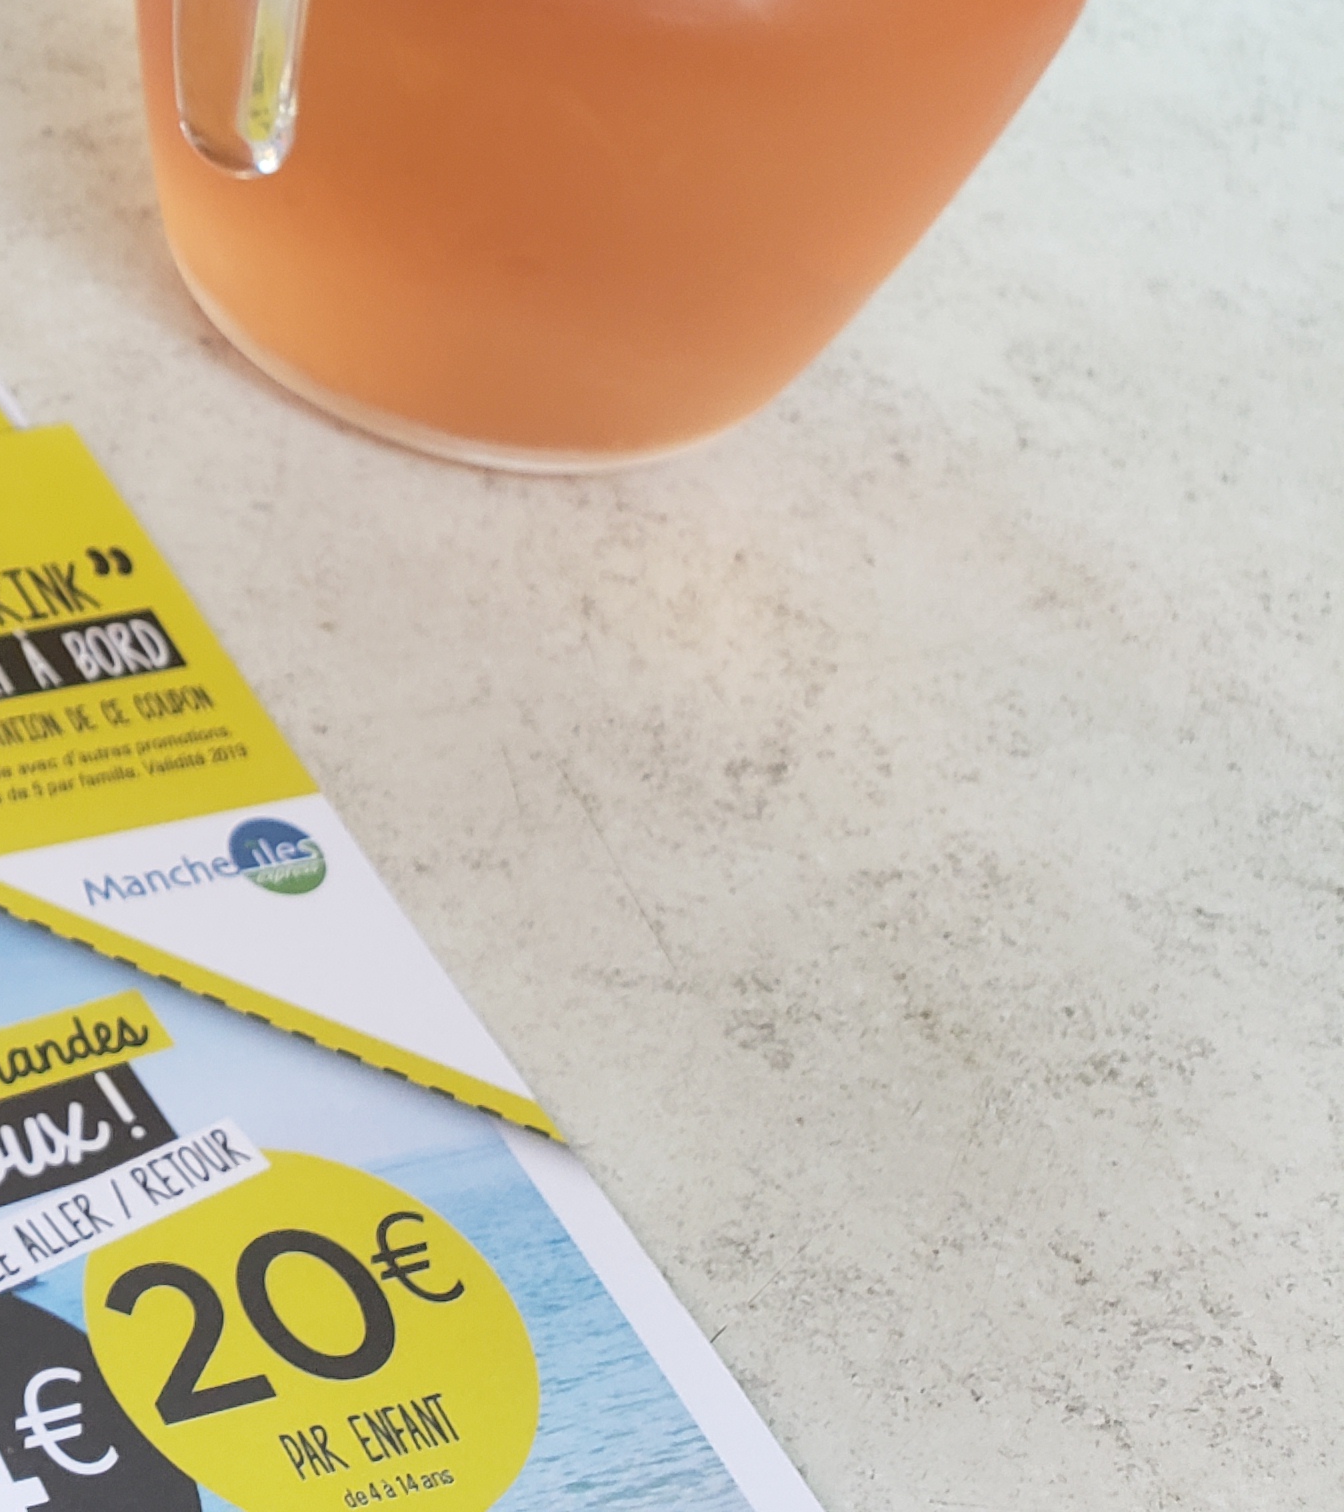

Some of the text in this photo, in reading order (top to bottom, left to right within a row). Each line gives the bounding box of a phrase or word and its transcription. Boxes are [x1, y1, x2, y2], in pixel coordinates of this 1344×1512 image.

[61, 618, 171, 683] BORD
[63, 701, 96, 732] DE
[99, 696, 131, 728] CE
[133, 684, 216, 721] COUPON
[6, 782, 29, 802] de
[46, 779, 76, 804] par
[143, 750, 208, 778] Validité
[17, 758, 58, 777] avec
[82, 853, 242, 907] Manche
[10, 1192, 115, 1267] ALLER
[127, 1126, 255, 1208] RETOUR
[278, 1392, 461, 1481] PAR ENFANT
[343, 1488, 370, 1509] de
[395, 1472, 420, 1497] 14
[419, 1468, 455, 1490] ans
